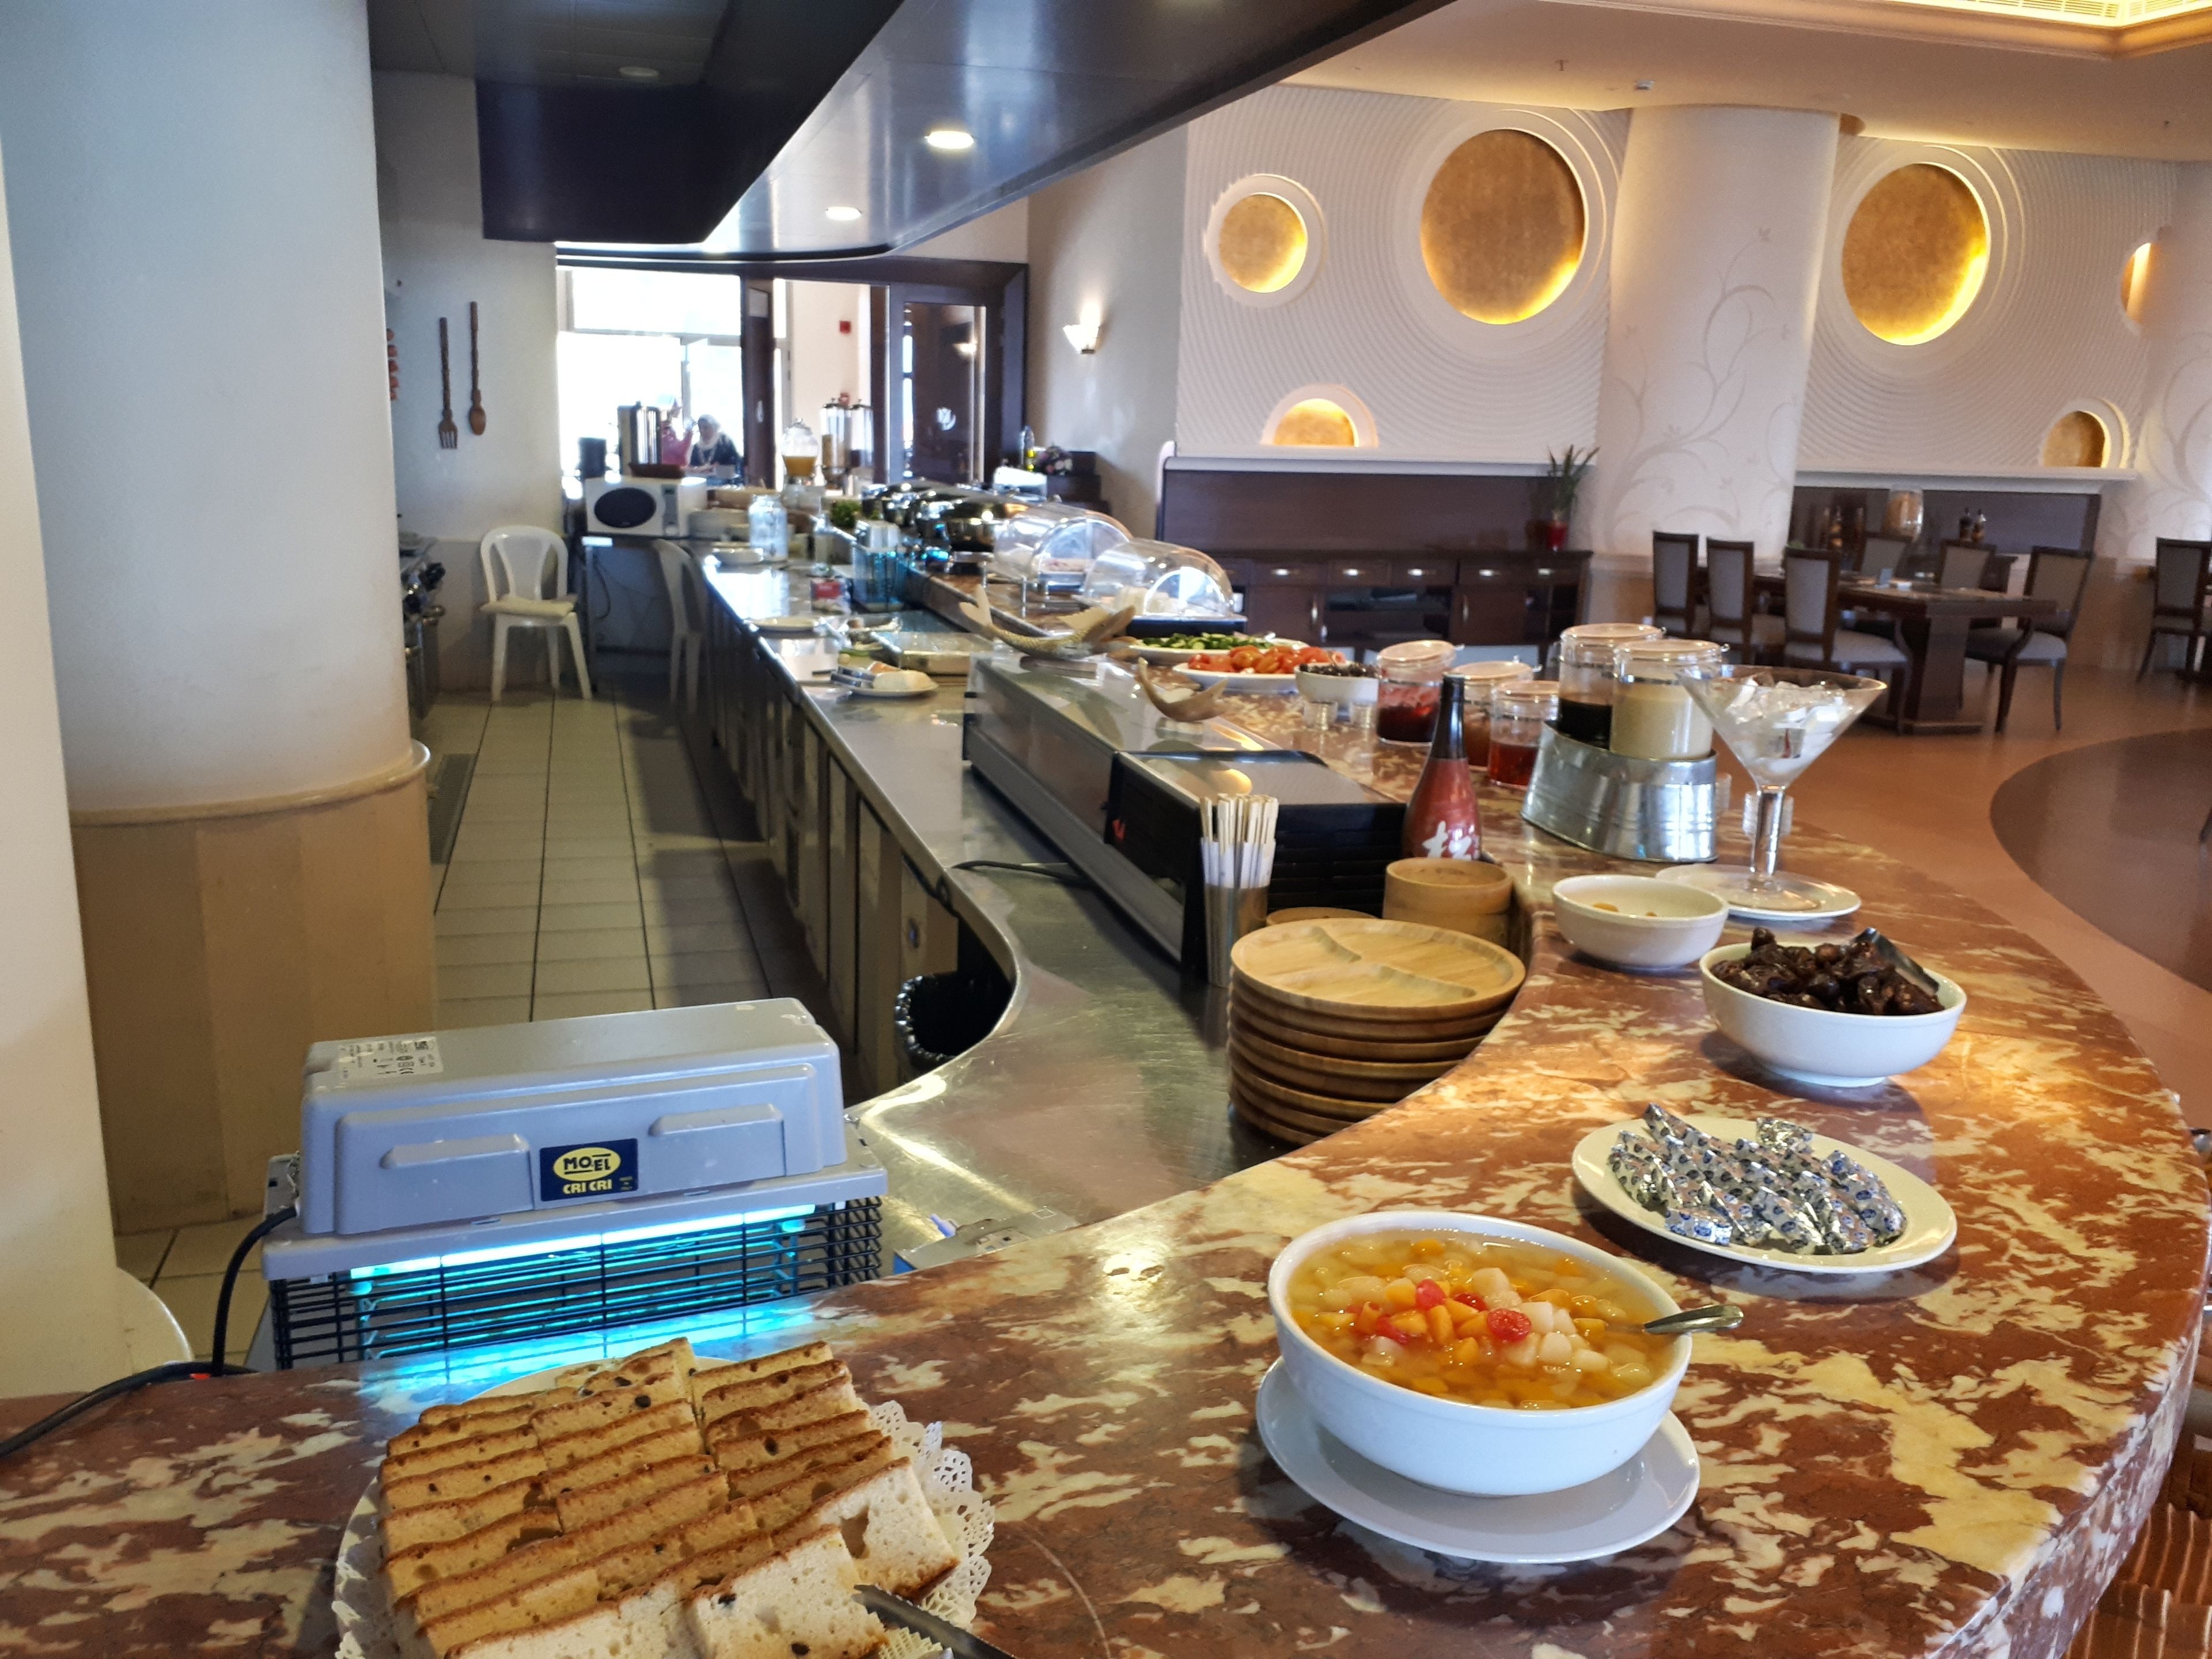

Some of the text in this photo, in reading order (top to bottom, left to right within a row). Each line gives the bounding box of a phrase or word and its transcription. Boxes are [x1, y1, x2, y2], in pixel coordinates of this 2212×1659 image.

[563, 1156, 611, 1171] MOEL
[563, 1182, 587, 1194] CRI
[589, 1179, 612, 1191] CRI
